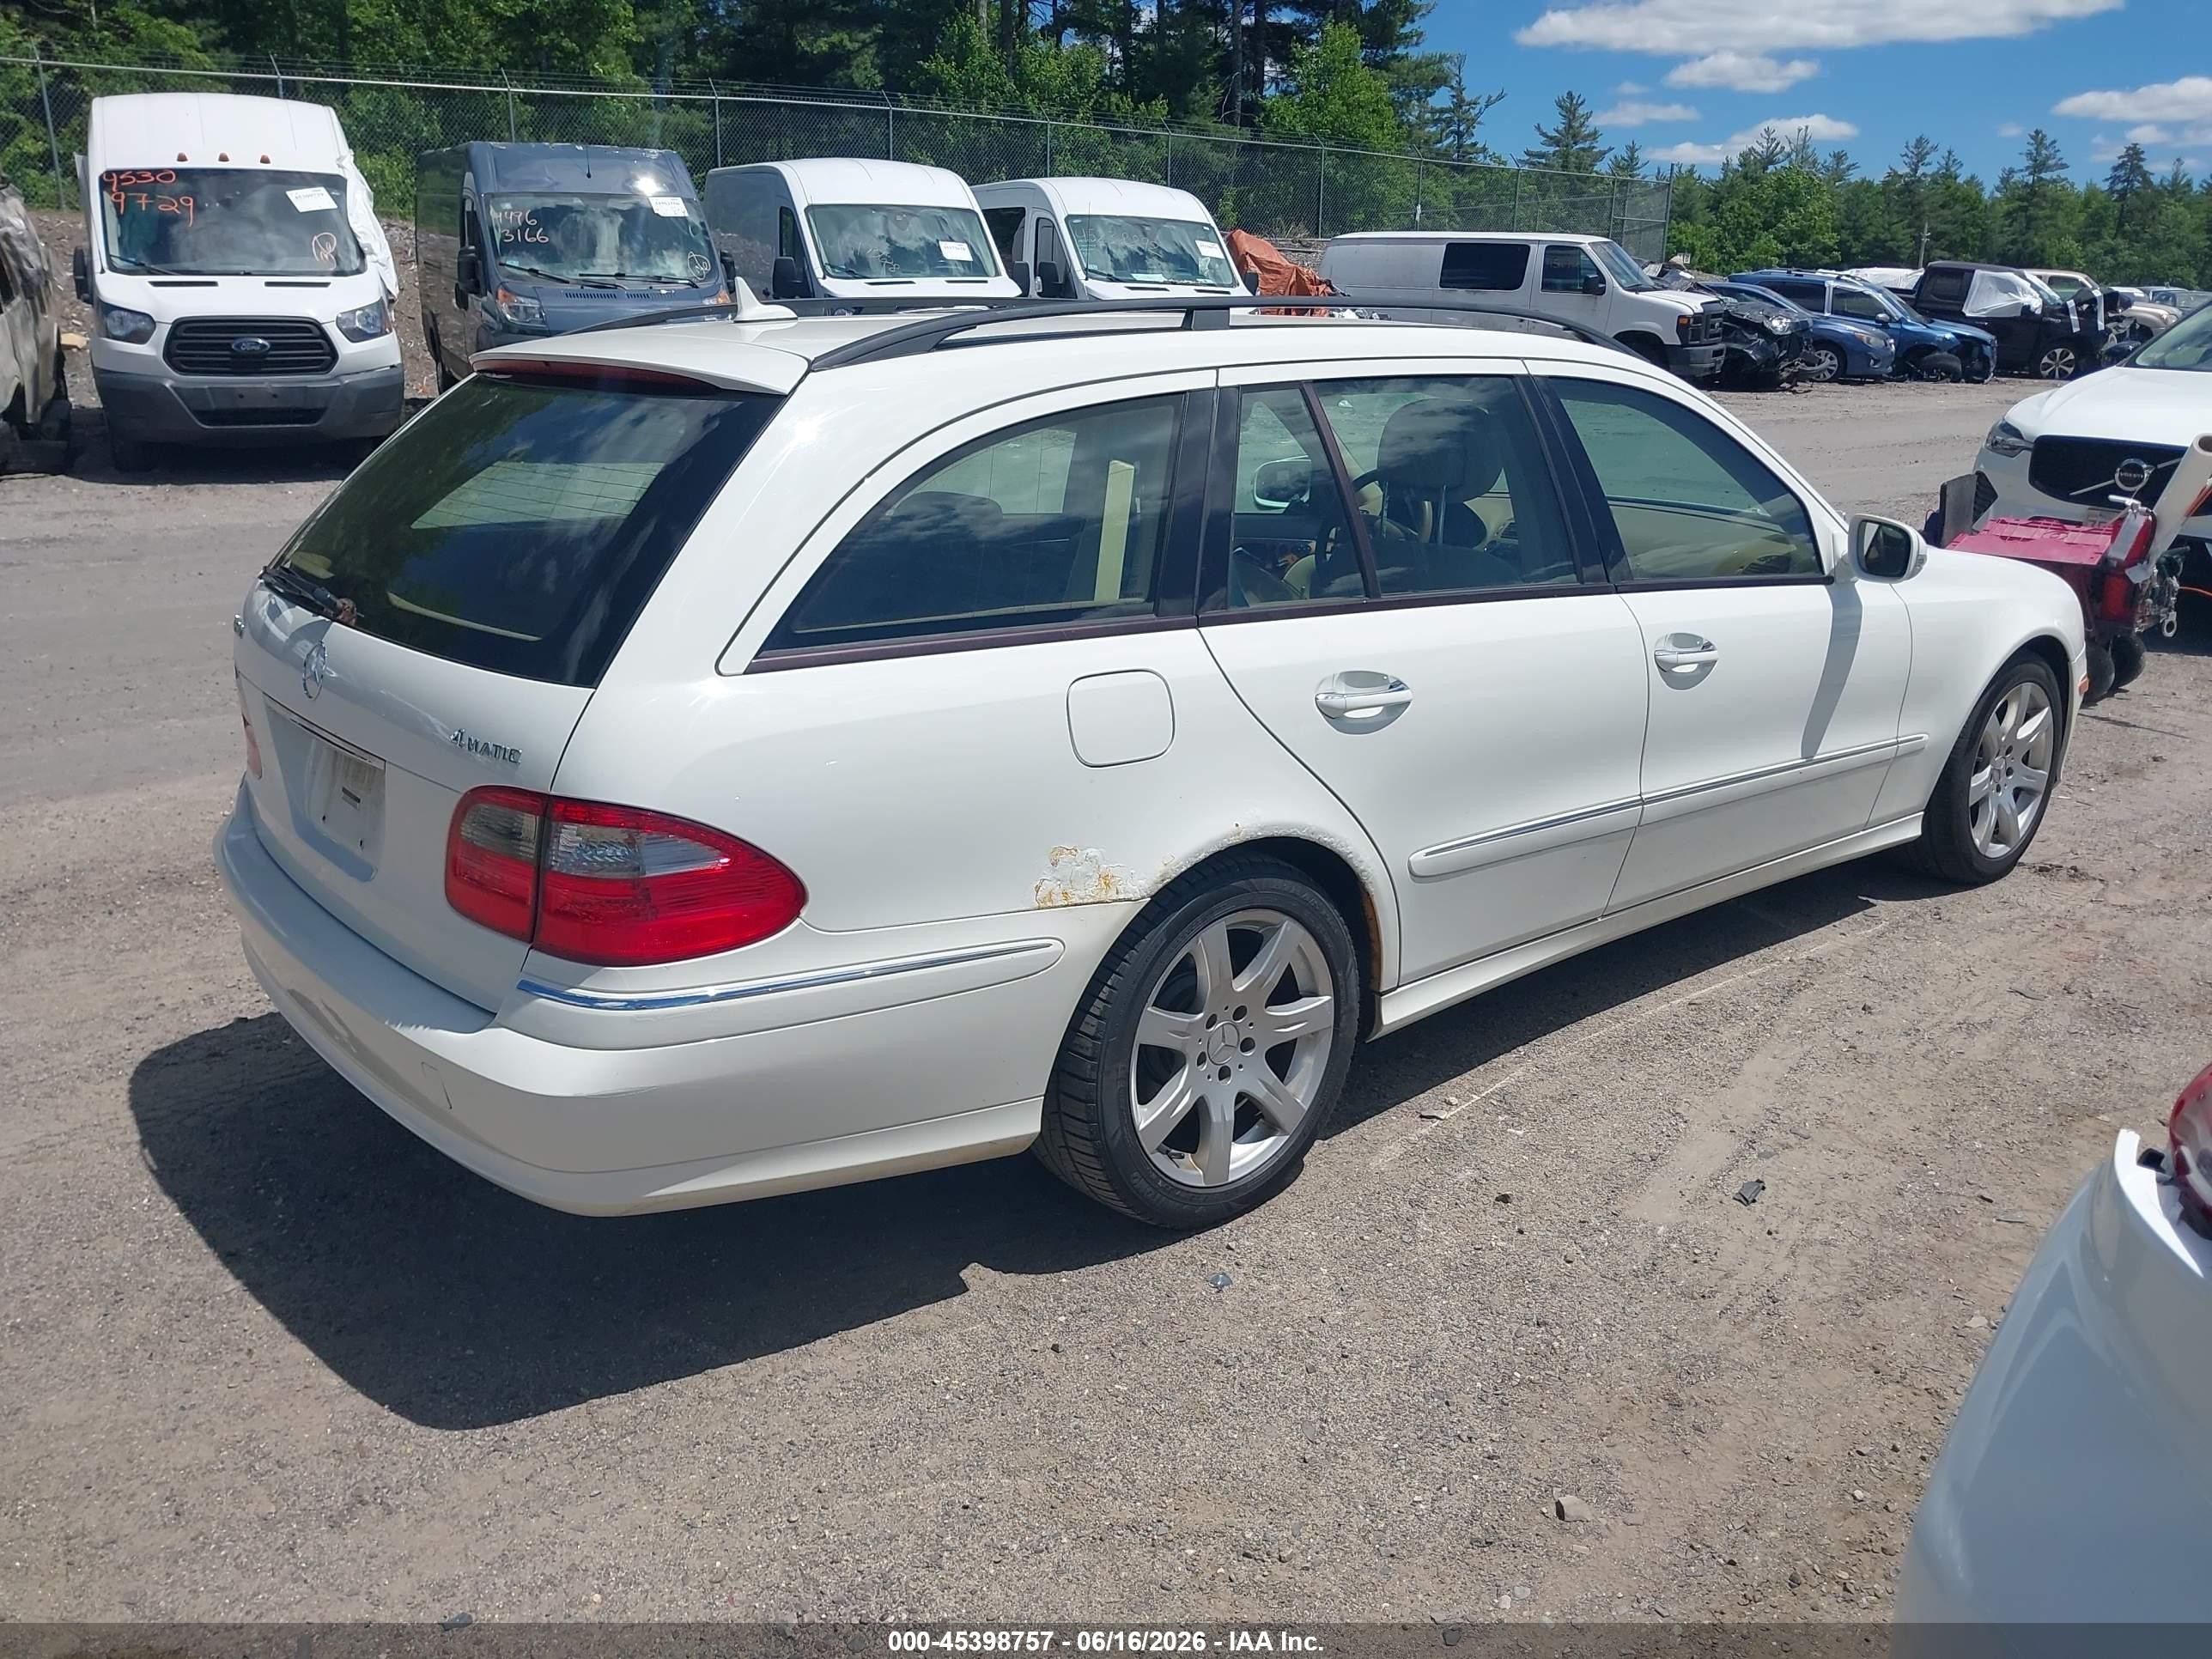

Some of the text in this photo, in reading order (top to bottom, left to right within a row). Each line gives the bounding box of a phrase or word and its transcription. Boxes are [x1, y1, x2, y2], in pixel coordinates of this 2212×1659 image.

[102, 170, 177, 192] 4530
[111, 191, 194, 228] 9729
[501, 228, 549, 243] 3166
